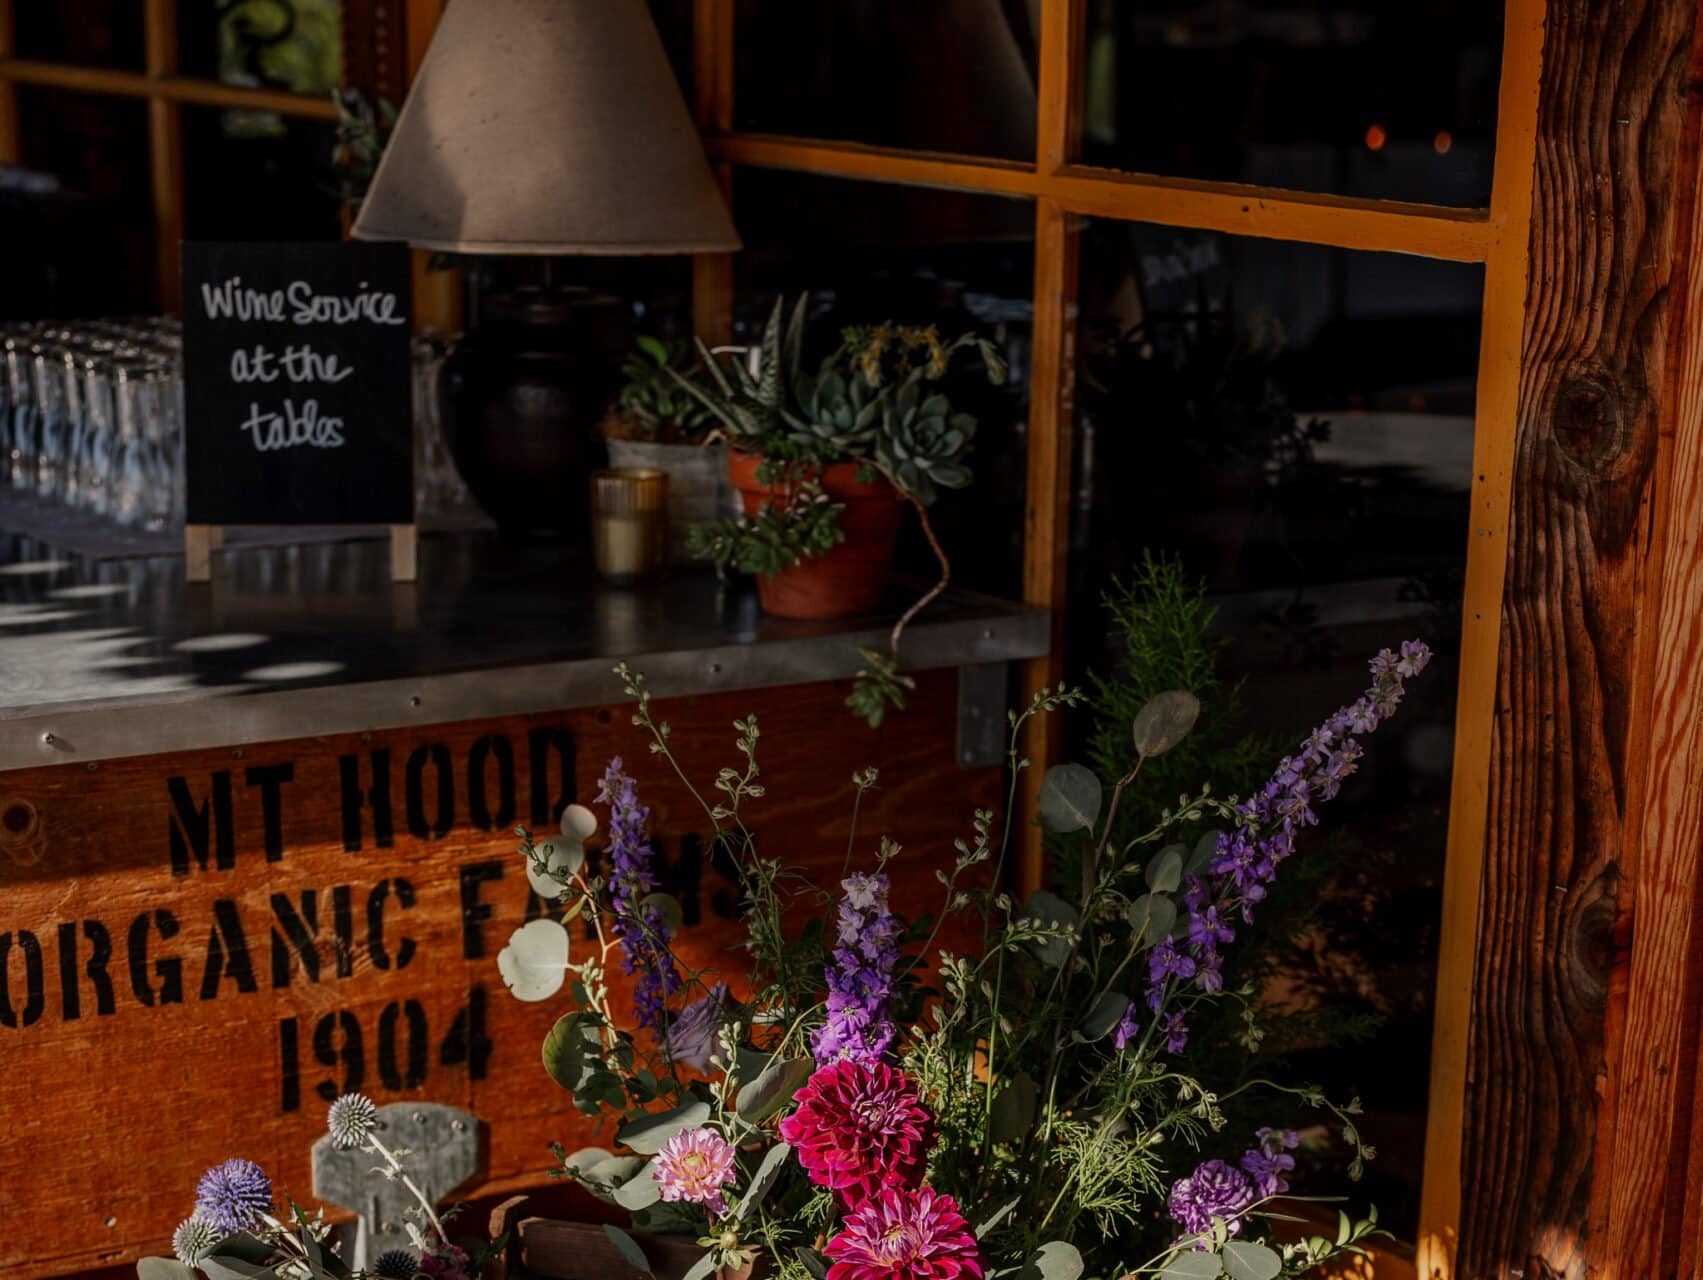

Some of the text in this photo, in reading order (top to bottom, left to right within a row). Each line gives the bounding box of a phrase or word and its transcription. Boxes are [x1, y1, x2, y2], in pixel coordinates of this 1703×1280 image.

[202, 276, 406, 325] Wine Service
[231, 345, 354, 382] at the
[241, 399, 345, 451] tables
[167, 726, 577, 877] MT HOOD
[0, 876, 417, 1029] ORGANIC
[279, 982, 494, 1112] 1904
